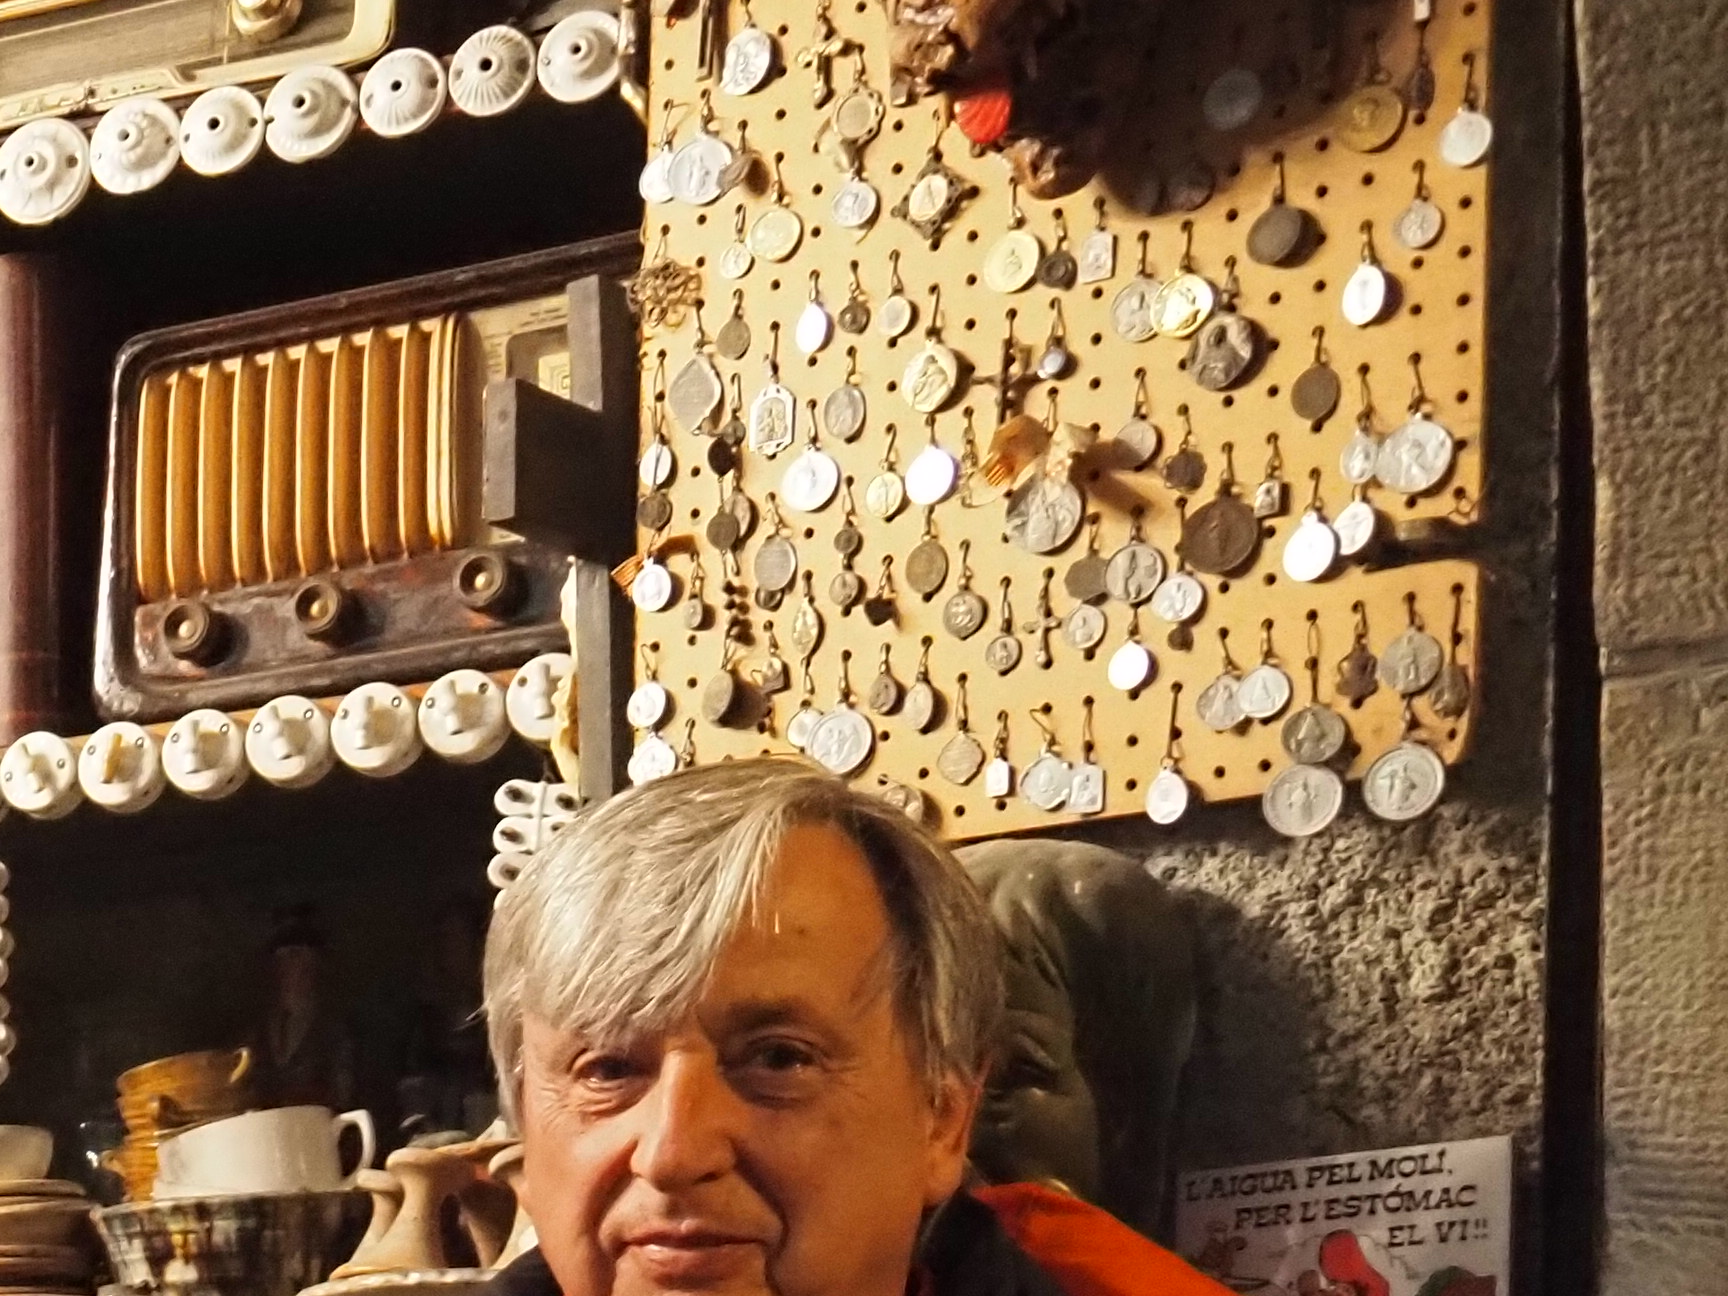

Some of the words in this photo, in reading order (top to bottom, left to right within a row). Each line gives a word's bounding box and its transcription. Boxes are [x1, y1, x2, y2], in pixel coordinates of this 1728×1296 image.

[1186, 1168, 1296, 1201] L'AIGUA
[1306, 1163, 1362, 1188] PEL
[1368, 1148, 1453, 1180] MOLÍ,
[1234, 1203, 1291, 1229] PER
[1299, 1183, 1477, 1223] L'ESTÓMAC
[1387, 1224, 1423, 1248] EL
[1435, 1217, 1488, 1243] VI!!
